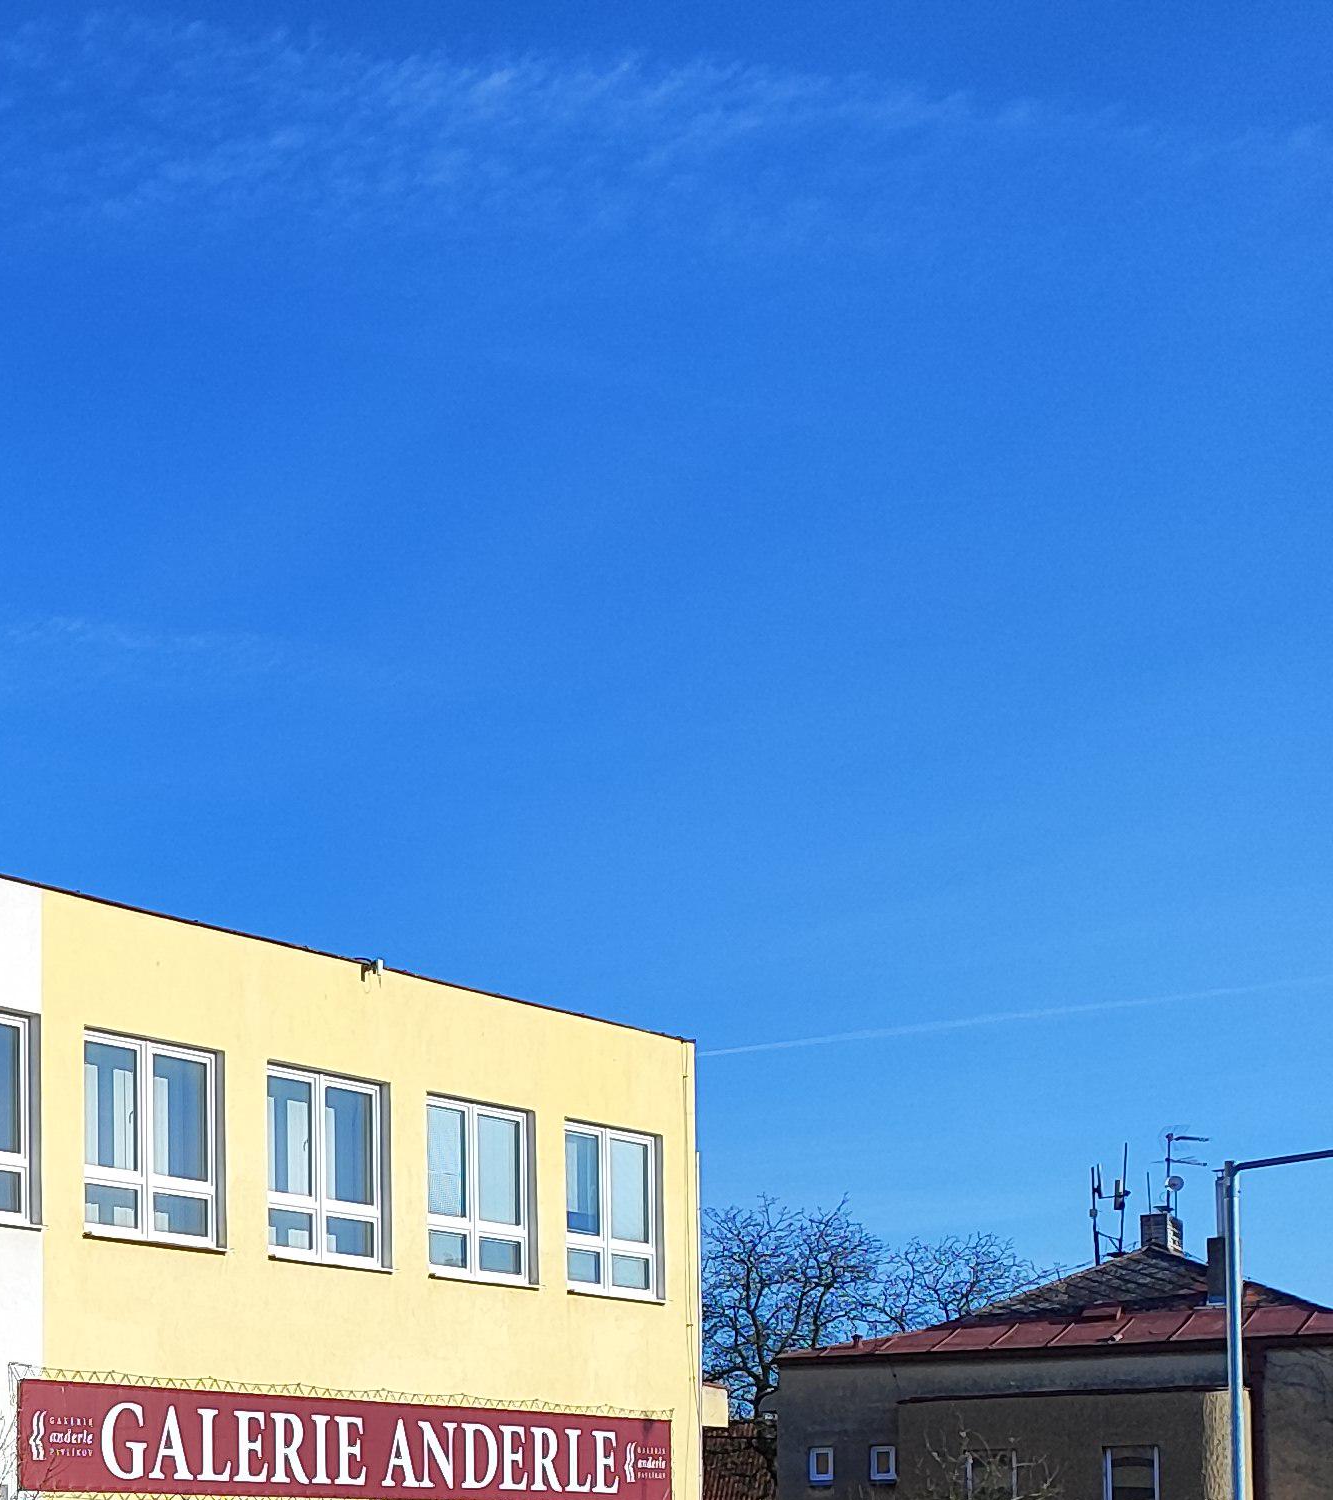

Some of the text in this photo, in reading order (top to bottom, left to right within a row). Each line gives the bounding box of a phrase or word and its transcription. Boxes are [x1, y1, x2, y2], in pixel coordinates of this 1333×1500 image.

[49, 1428, 93, 1444] anderle
[101, 1402, 621, 1495] GALERIE ANDERLE
